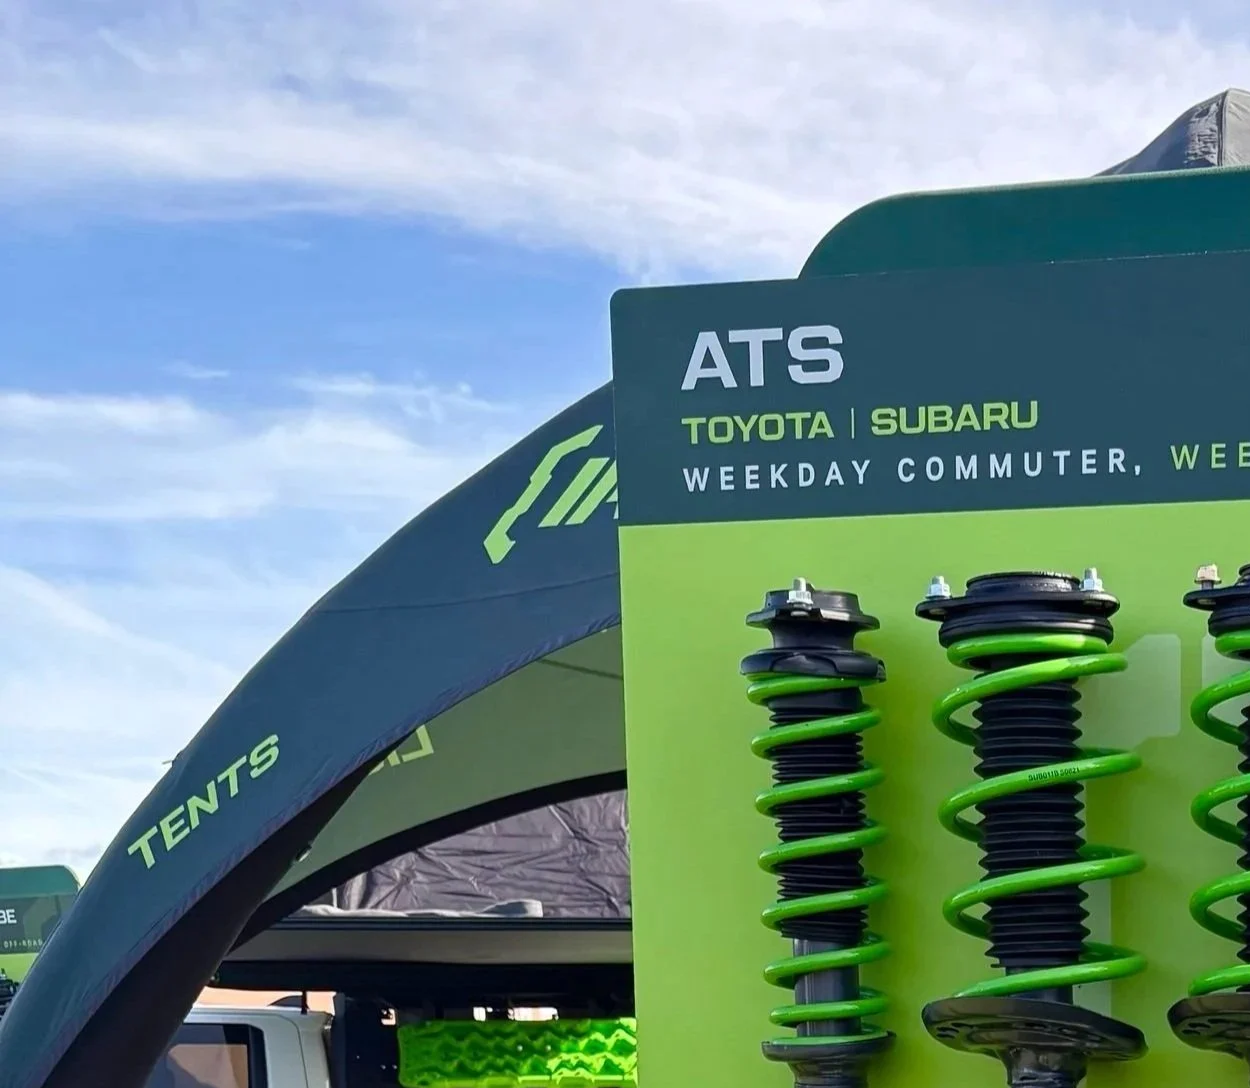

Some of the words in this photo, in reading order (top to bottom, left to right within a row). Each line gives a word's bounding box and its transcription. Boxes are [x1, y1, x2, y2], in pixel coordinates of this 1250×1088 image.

[680, 324, 844, 391] ATS
[681, 410, 835, 444] TOYOTA
[871, 400, 1039, 436] SUBARU
[682, 459, 871, 492] WEEKDAY
[897, 447, 1142, 482] COMMUTER,
[127, 734, 280, 869] TENTS
